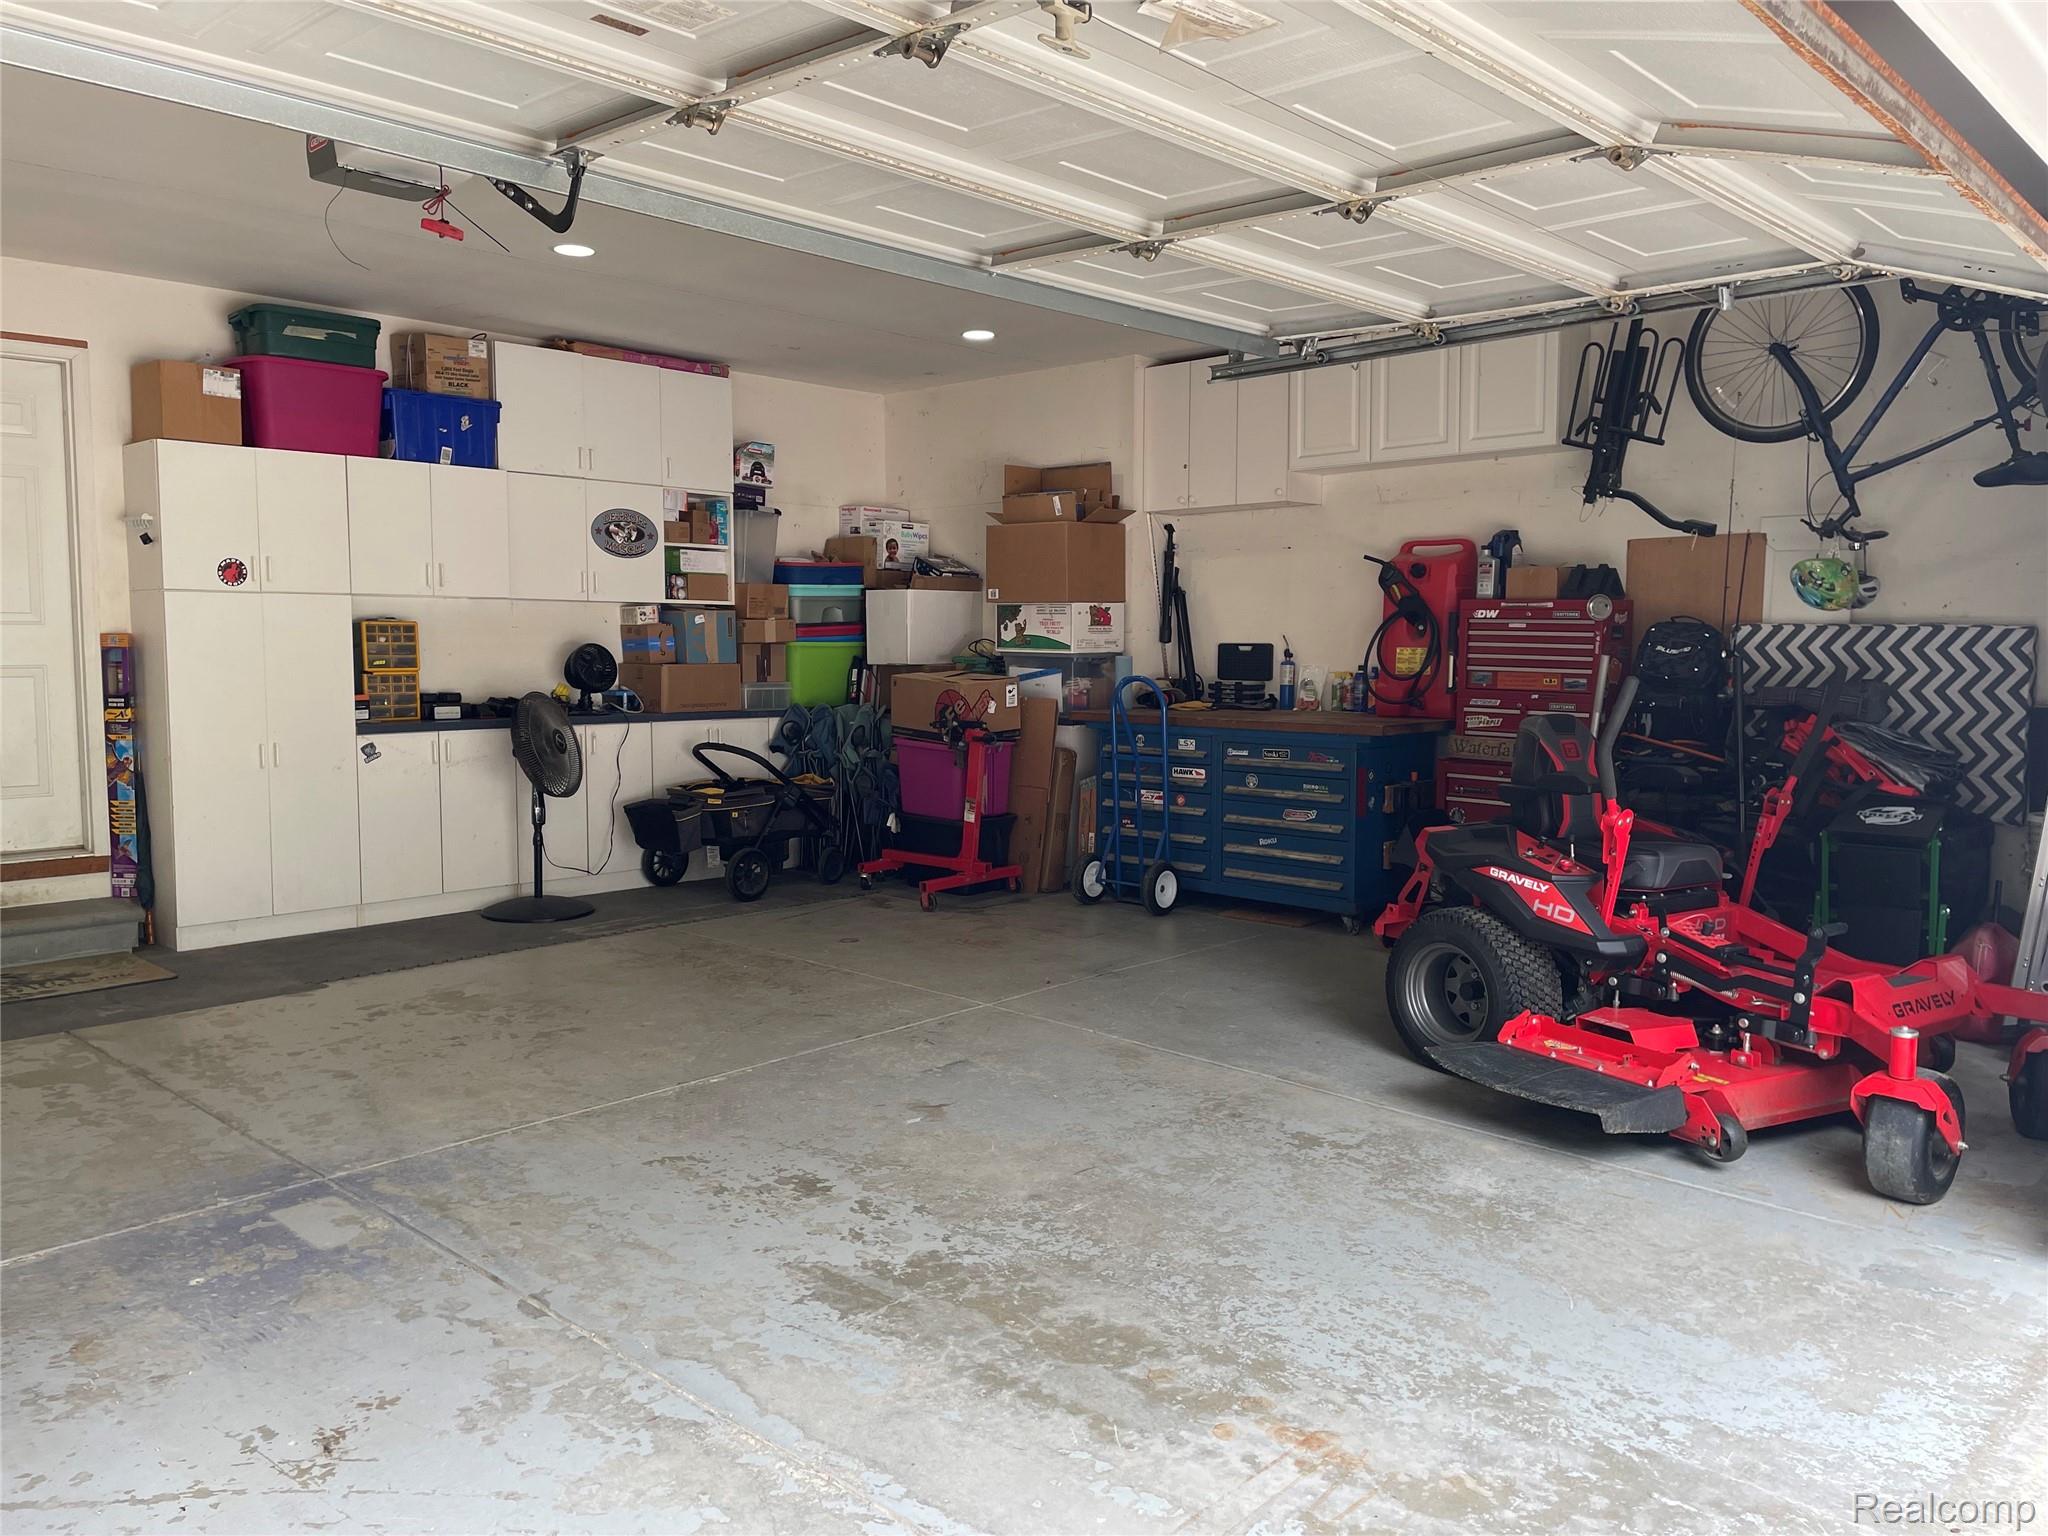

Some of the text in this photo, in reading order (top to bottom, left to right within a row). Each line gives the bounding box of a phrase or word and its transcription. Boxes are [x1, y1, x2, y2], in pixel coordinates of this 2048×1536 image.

[912, 532, 929, 541] Wipes
[1454, 740, 1513, 758] Waterfa
[1173, 768, 1194, 776] HAWK
[1489, 867, 1550, 893] GRAVELY
[1533, 899, 1576, 923] HD
[1892, 990, 1956, 1018] GRAVELY
